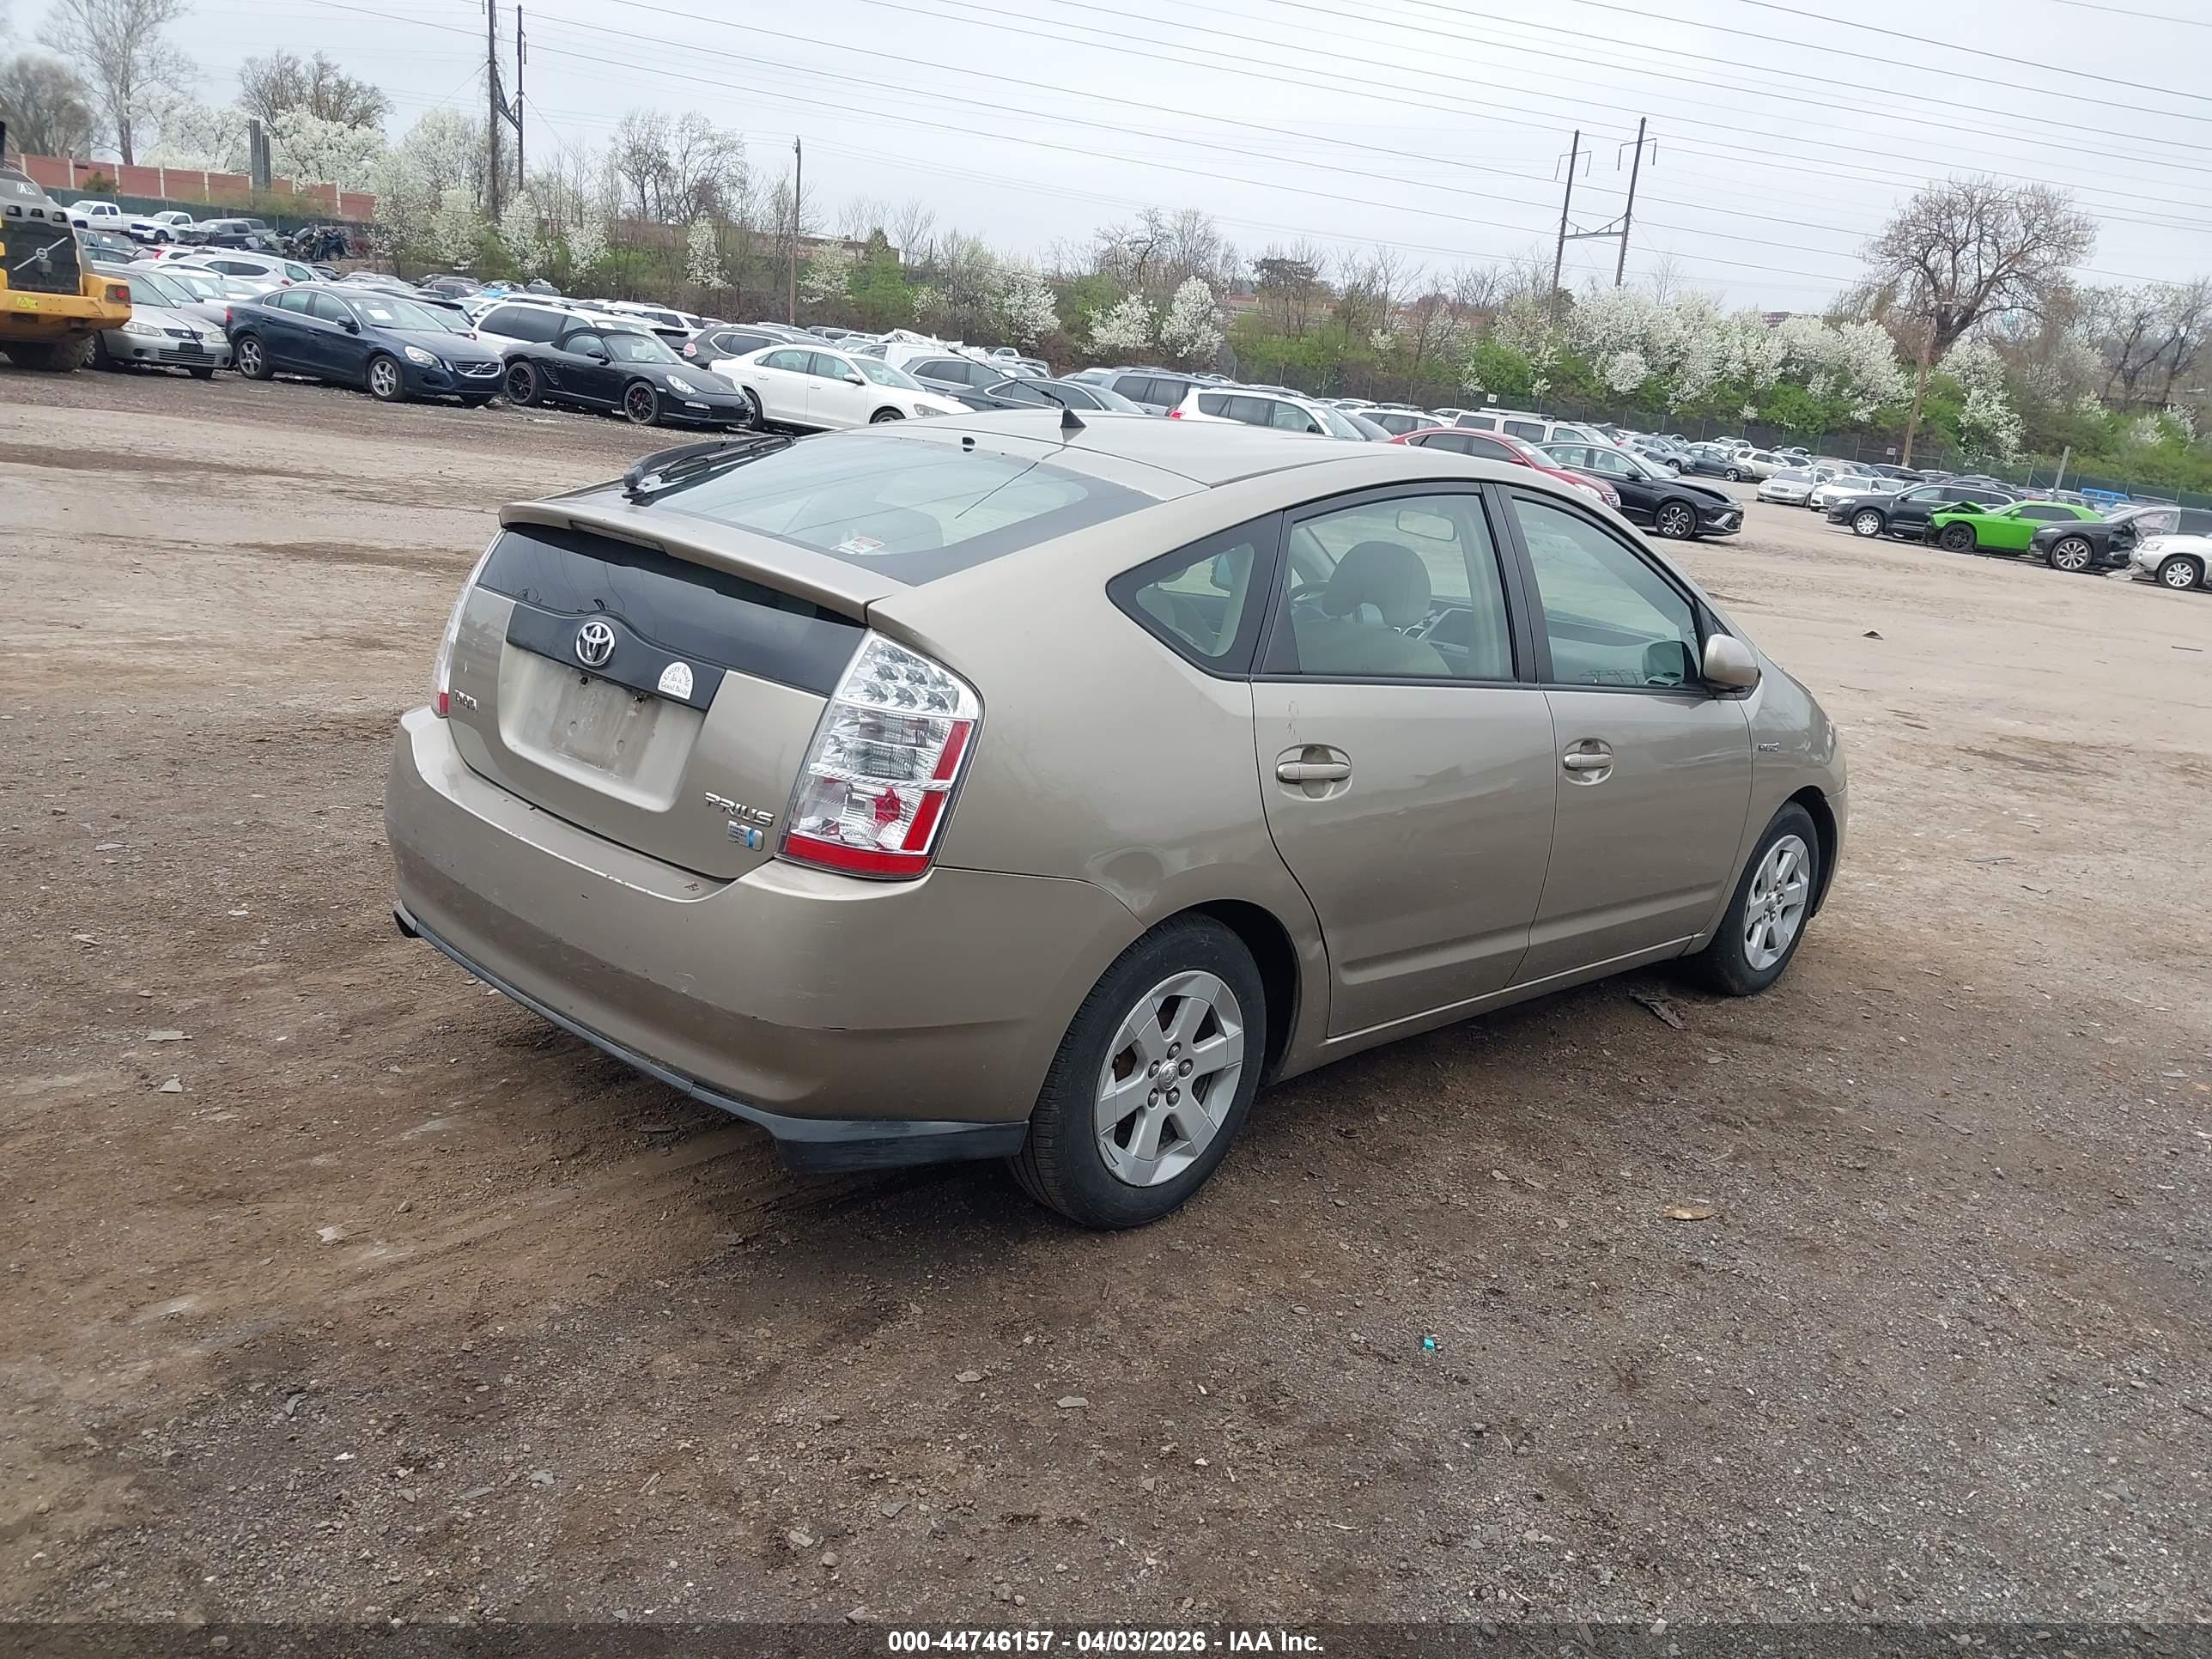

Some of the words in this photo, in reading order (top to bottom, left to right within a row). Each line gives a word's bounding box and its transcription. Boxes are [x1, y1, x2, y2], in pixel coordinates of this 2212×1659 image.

[660, 680, 676, 690] Good
[675, 685, 690, 696] Body
[705, 791, 775, 827] PRIUS
